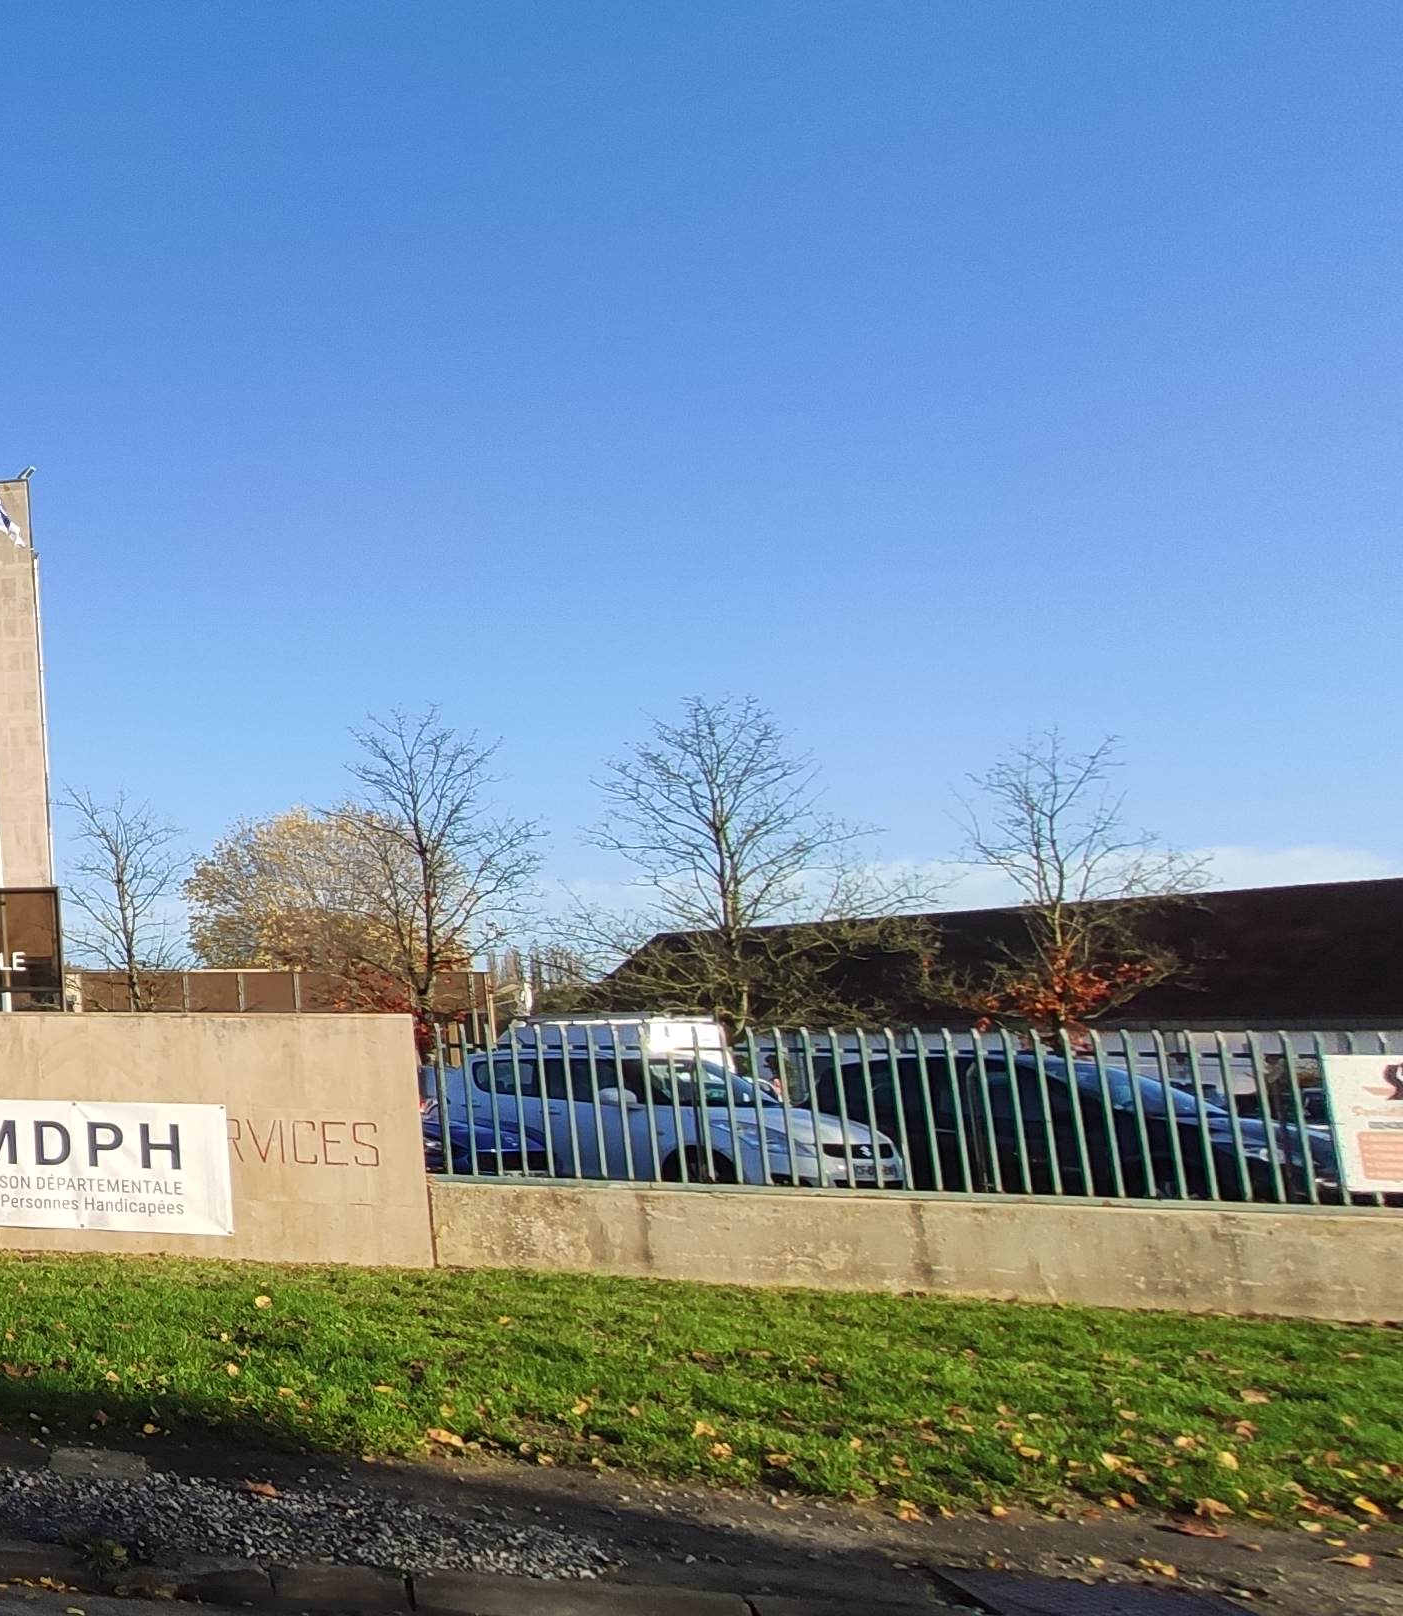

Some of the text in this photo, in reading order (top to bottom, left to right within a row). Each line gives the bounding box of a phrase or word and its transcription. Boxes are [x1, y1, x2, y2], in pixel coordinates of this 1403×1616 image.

[35, 1174, 184, 1197] DÉPARTEMENTALE
[0, 1193, 80, 1212] Personnes
[84, 1196, 185, 1217] Handicapées
